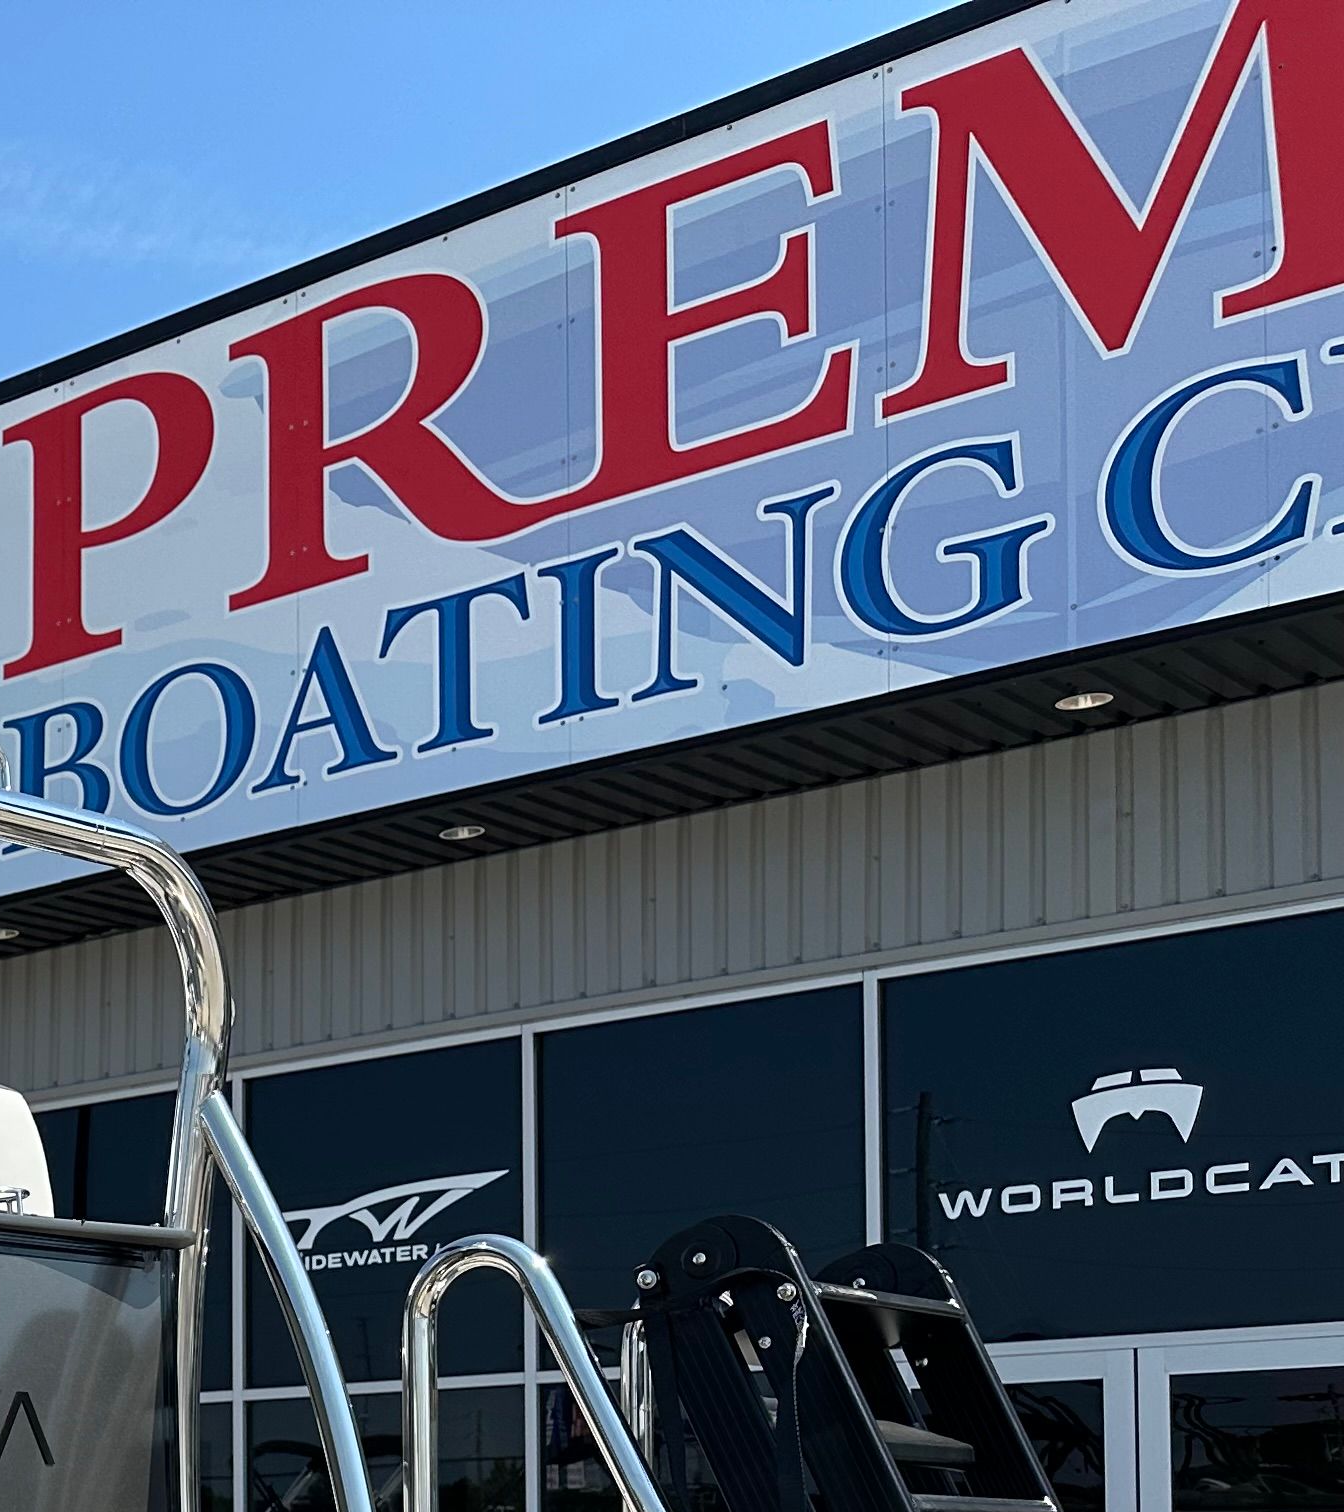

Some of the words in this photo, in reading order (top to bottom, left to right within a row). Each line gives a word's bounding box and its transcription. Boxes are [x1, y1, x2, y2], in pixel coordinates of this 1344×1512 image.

[1, 0, 1344, 679] PREM
[1, 439, 1049, 855] BOATING
[1104, 343, 1344, 571] C
[300, 1244, 429, 1271] IDEWATER
[938, 1152, 1344, 1220] WORLDCAT
